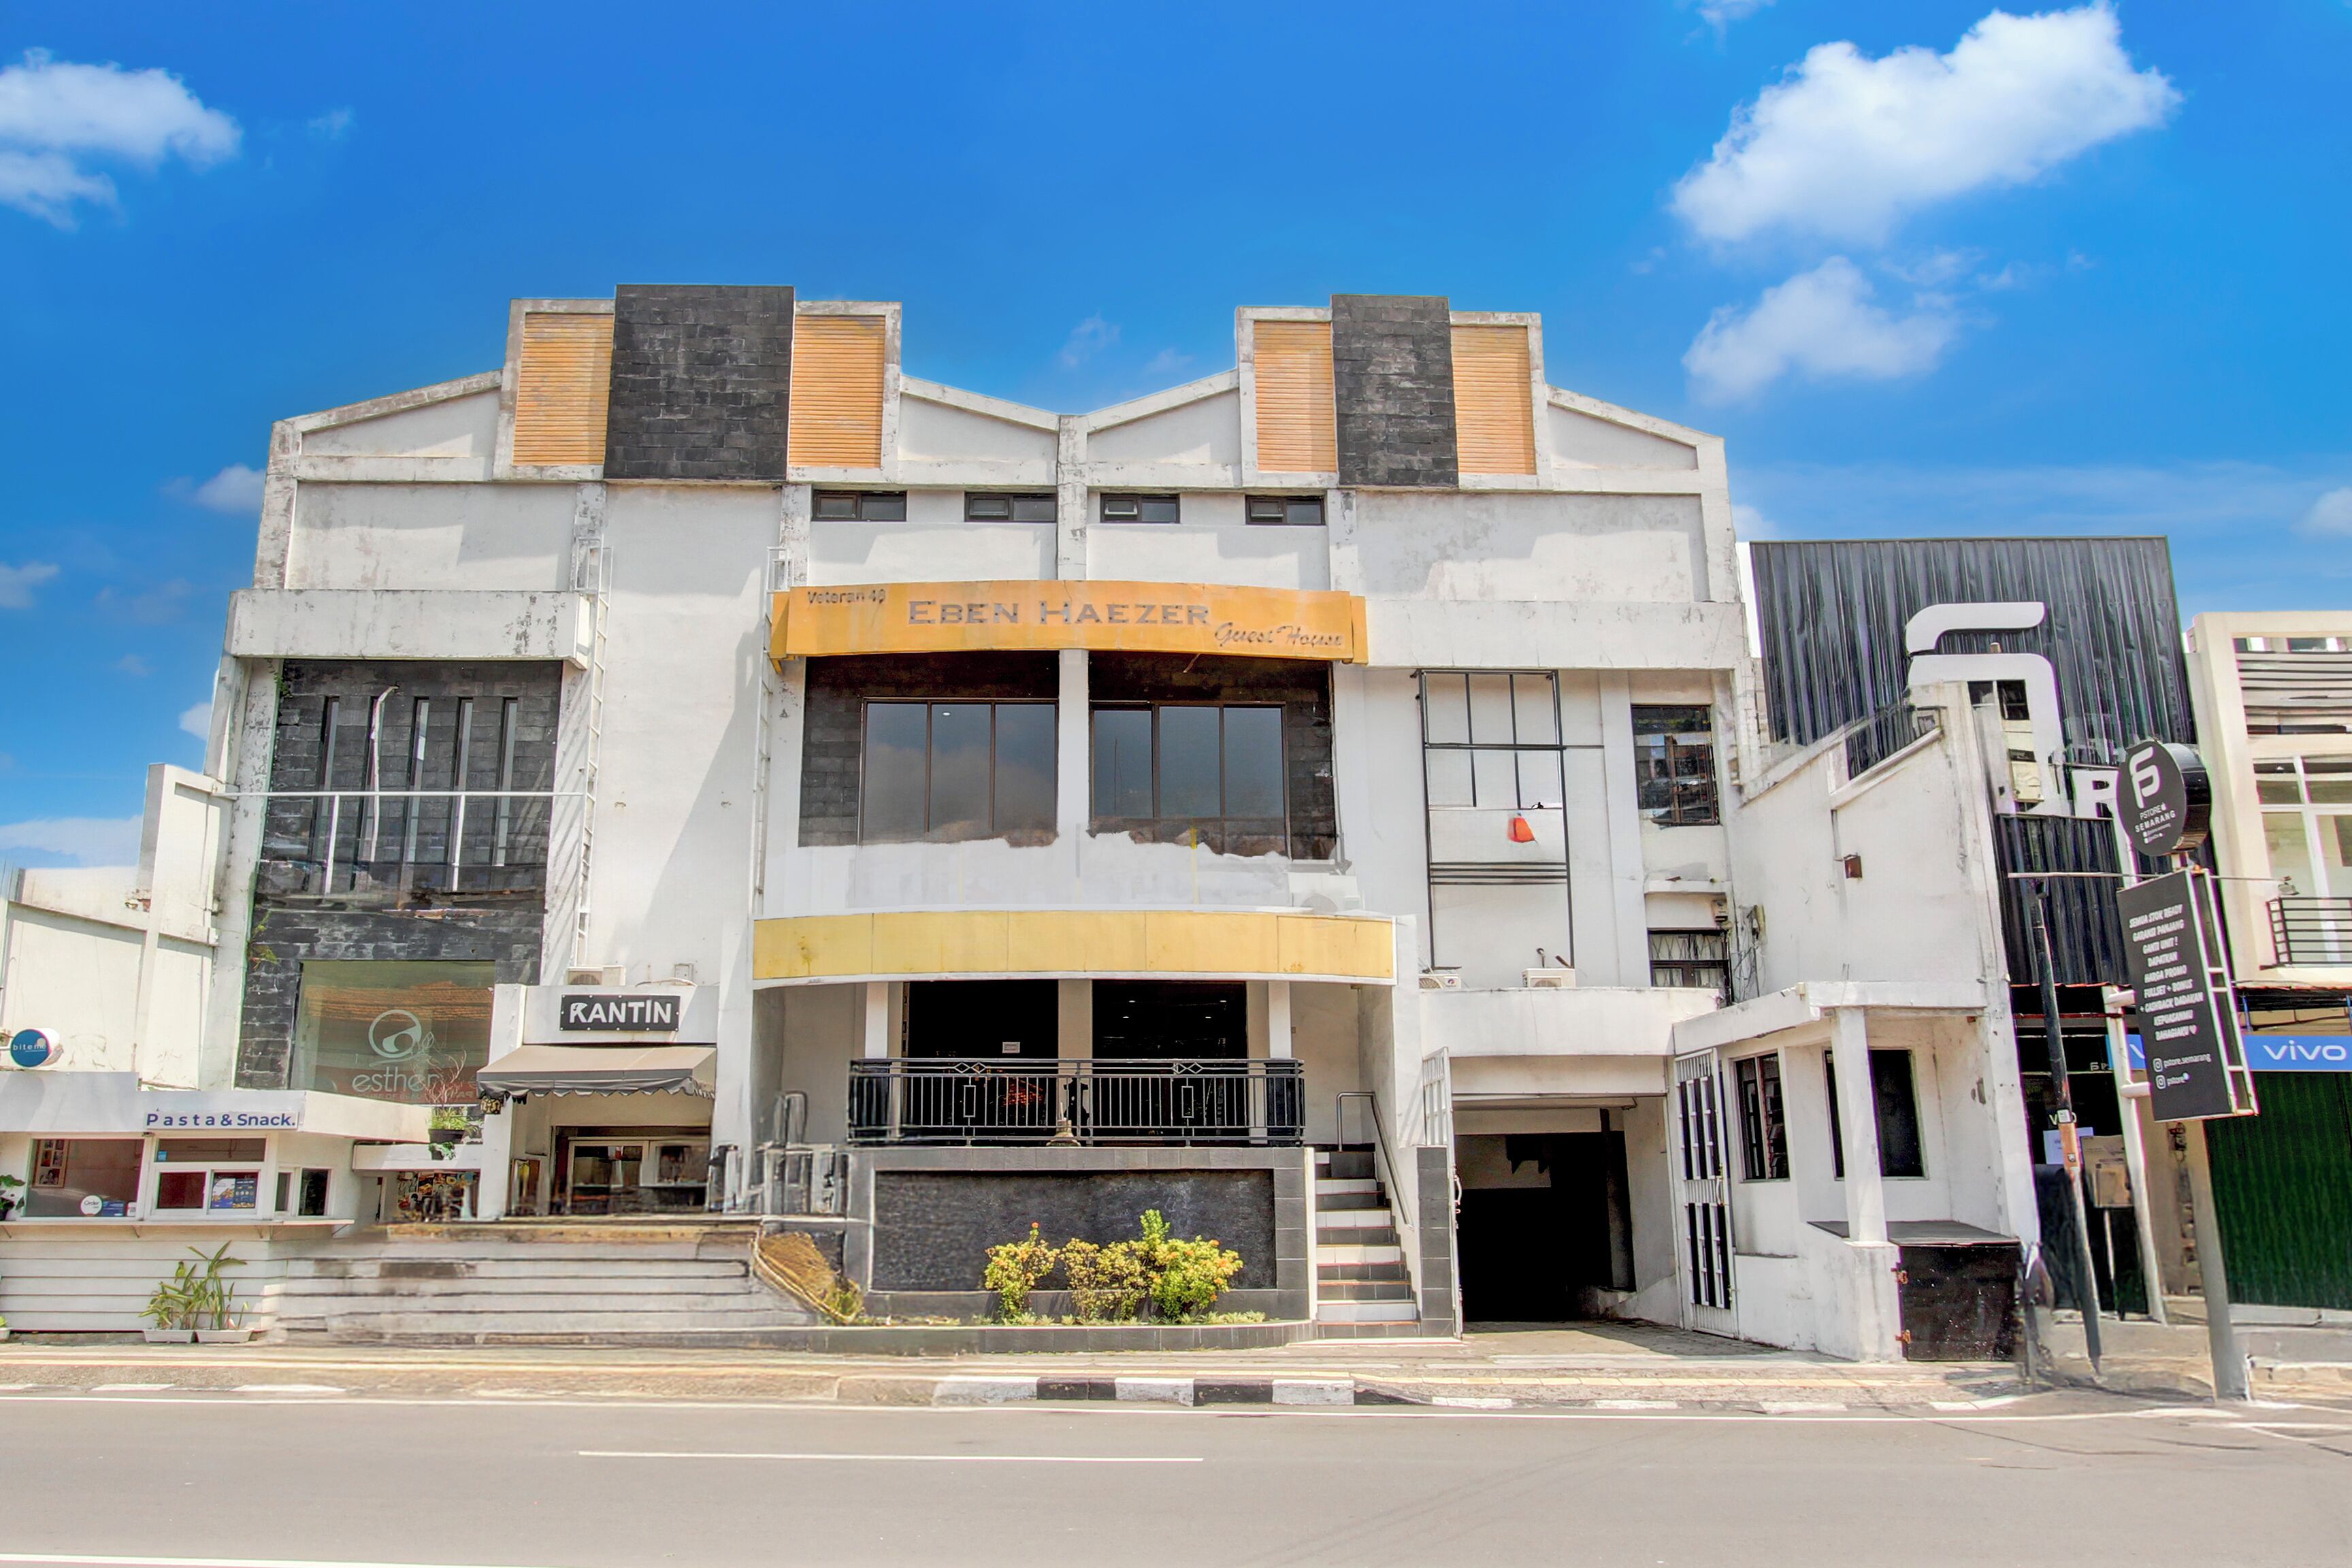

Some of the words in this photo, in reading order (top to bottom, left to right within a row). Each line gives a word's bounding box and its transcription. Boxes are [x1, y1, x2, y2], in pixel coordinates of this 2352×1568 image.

[807, 591, 865, 604] Veteran
[909, 600, 1019, 625] EBEN
[1039, 600, 1210, 625] HAEZER
[1214, 622, 1275, 647] Guest
[1276, 625, 1343, 648] House
[2134, 810, 2176, 833] SEMARANG
[2140, 804, 2162, 821] PSTORE
[2129, 914, 2149, 929] SEMUA
[2149, 910, 2164, 923] STOK
[2163, 904, 2183, 919] READY
[2132, 927, 2157, 942] GARANSI
[2157, 919, 2185, 936] PANJANG
[2142, 941, 2160, 955] GANTI
[2147, 951, 2178, 968] DAPATKAN
[2144, 970, 2164, 983] HARGA
[2164, 964, 2187, 979] PROMO
[2144, 985, 2166, 999] FULLSET
[2172, 979, 2193, 992] BONUS
[569, 1000, 672, 1024] KANTIN
[2144, 998, 2174, 1013] CASHBACK
[2174, 992, 2204, 1007] DADAKAN
[2153, 1009, 2193, 1026] KEPUASANMU
[2155, 1026, 2189, 1041] BAHAGIAKU
[2262, 1039, 2347, 1061] vivo
[2163, 1054, 2211, 1068] pstore.semarang
[352, 1066, 440, 1092] esther
[220, 1114, 232, 1126] &
[238, 1113, 295, 1126] Snack.
